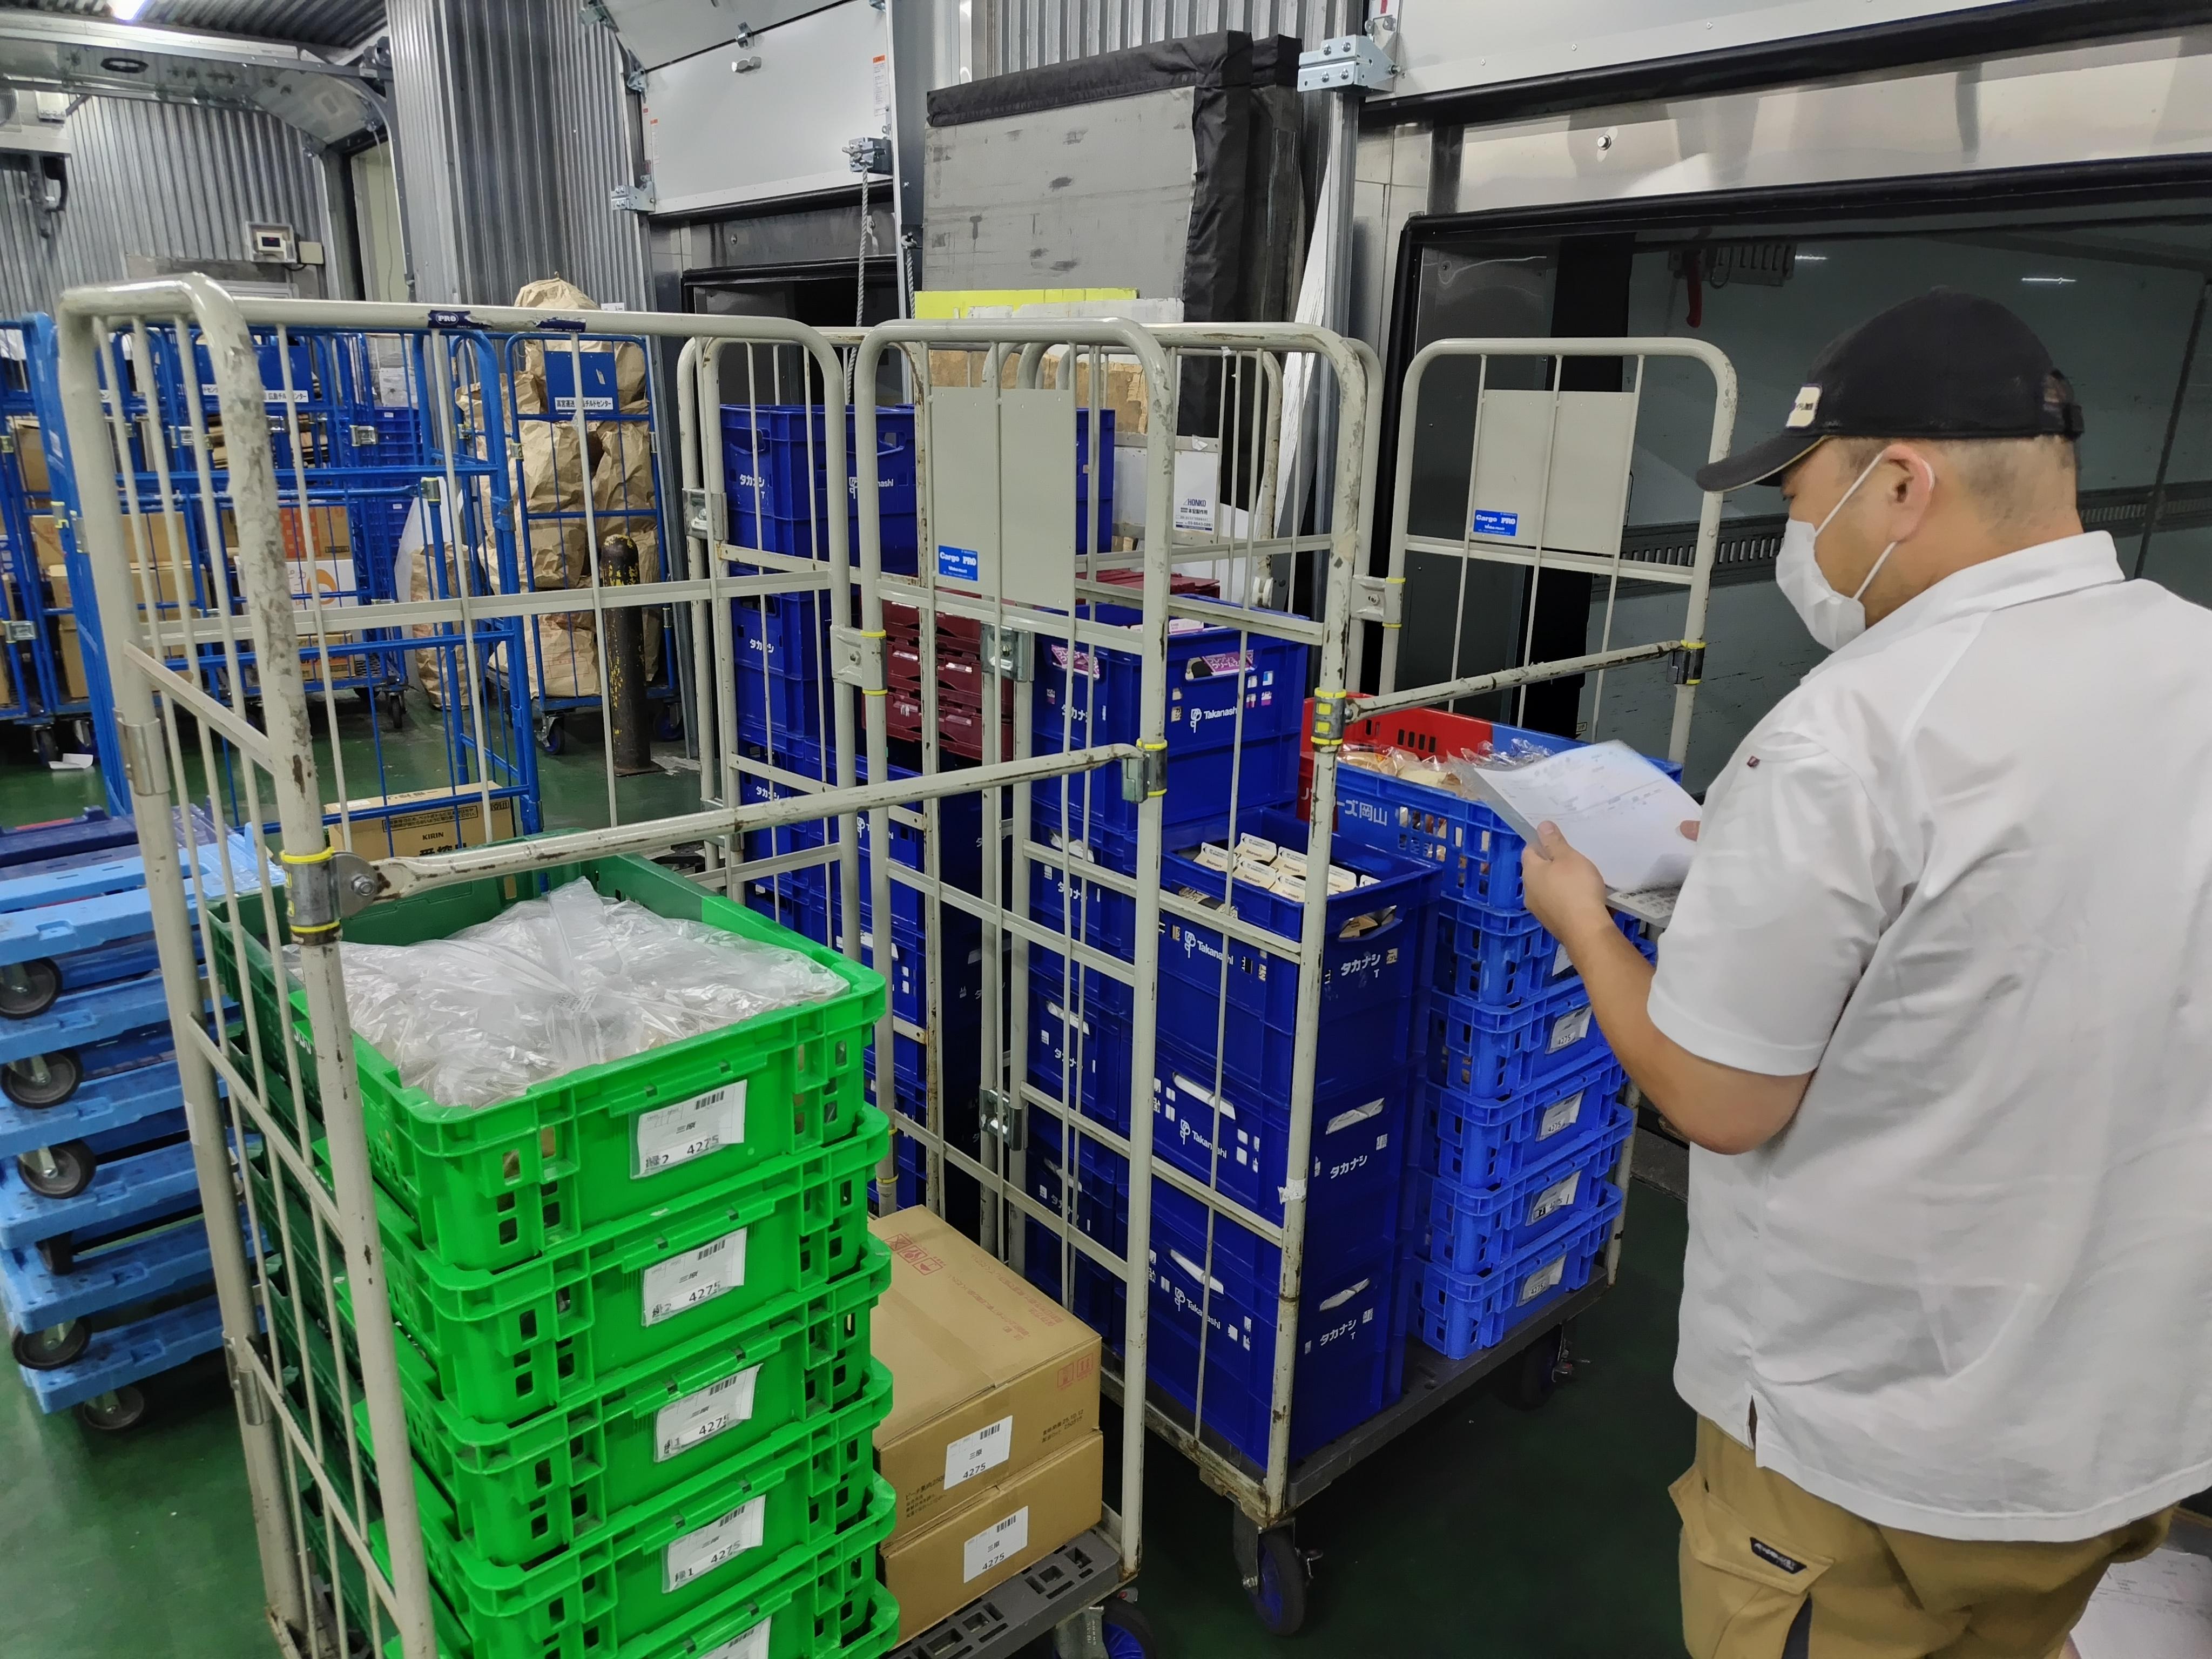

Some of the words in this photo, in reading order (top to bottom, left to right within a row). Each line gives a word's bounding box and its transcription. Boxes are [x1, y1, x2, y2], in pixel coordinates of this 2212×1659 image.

[739, 474, 765, 488] タカシ
[1188, 498, 1206, 507] HONKO
[1475, 514, 1498, 523] Cargo
[940, 551, 960, 563] Cargo
[962, 556, 977, 566] PRO
[749, 638, 774, 653] タカシ
[1203, 706, 1238, 720] Takanash
[756, 786, 779, 800] タカシ
[422, 831, 444, 841] KIRIN
[1197, 940, 1233, 965] Takanahi
[1340, 954, 1381, 976] タカナシ
[686, 1134, 719, 1155] 4275
[1192, 1130, 1227, 1158] Takanshi
[1330, 1155, 1368, 1179] タカナシ
[1186, 1298, 1220, 1330] Takaashi
[1320, 1319, 1357, 1346] タカナシ
[969, 1448, 983, 1460] 三原
[962, 1462, 986, 1478] 4275
[710, 1540, 740, 1563] 4275
[987, 1540, 1000, 1553] 三原
[982, 1552, 1004, 1570] 4275
